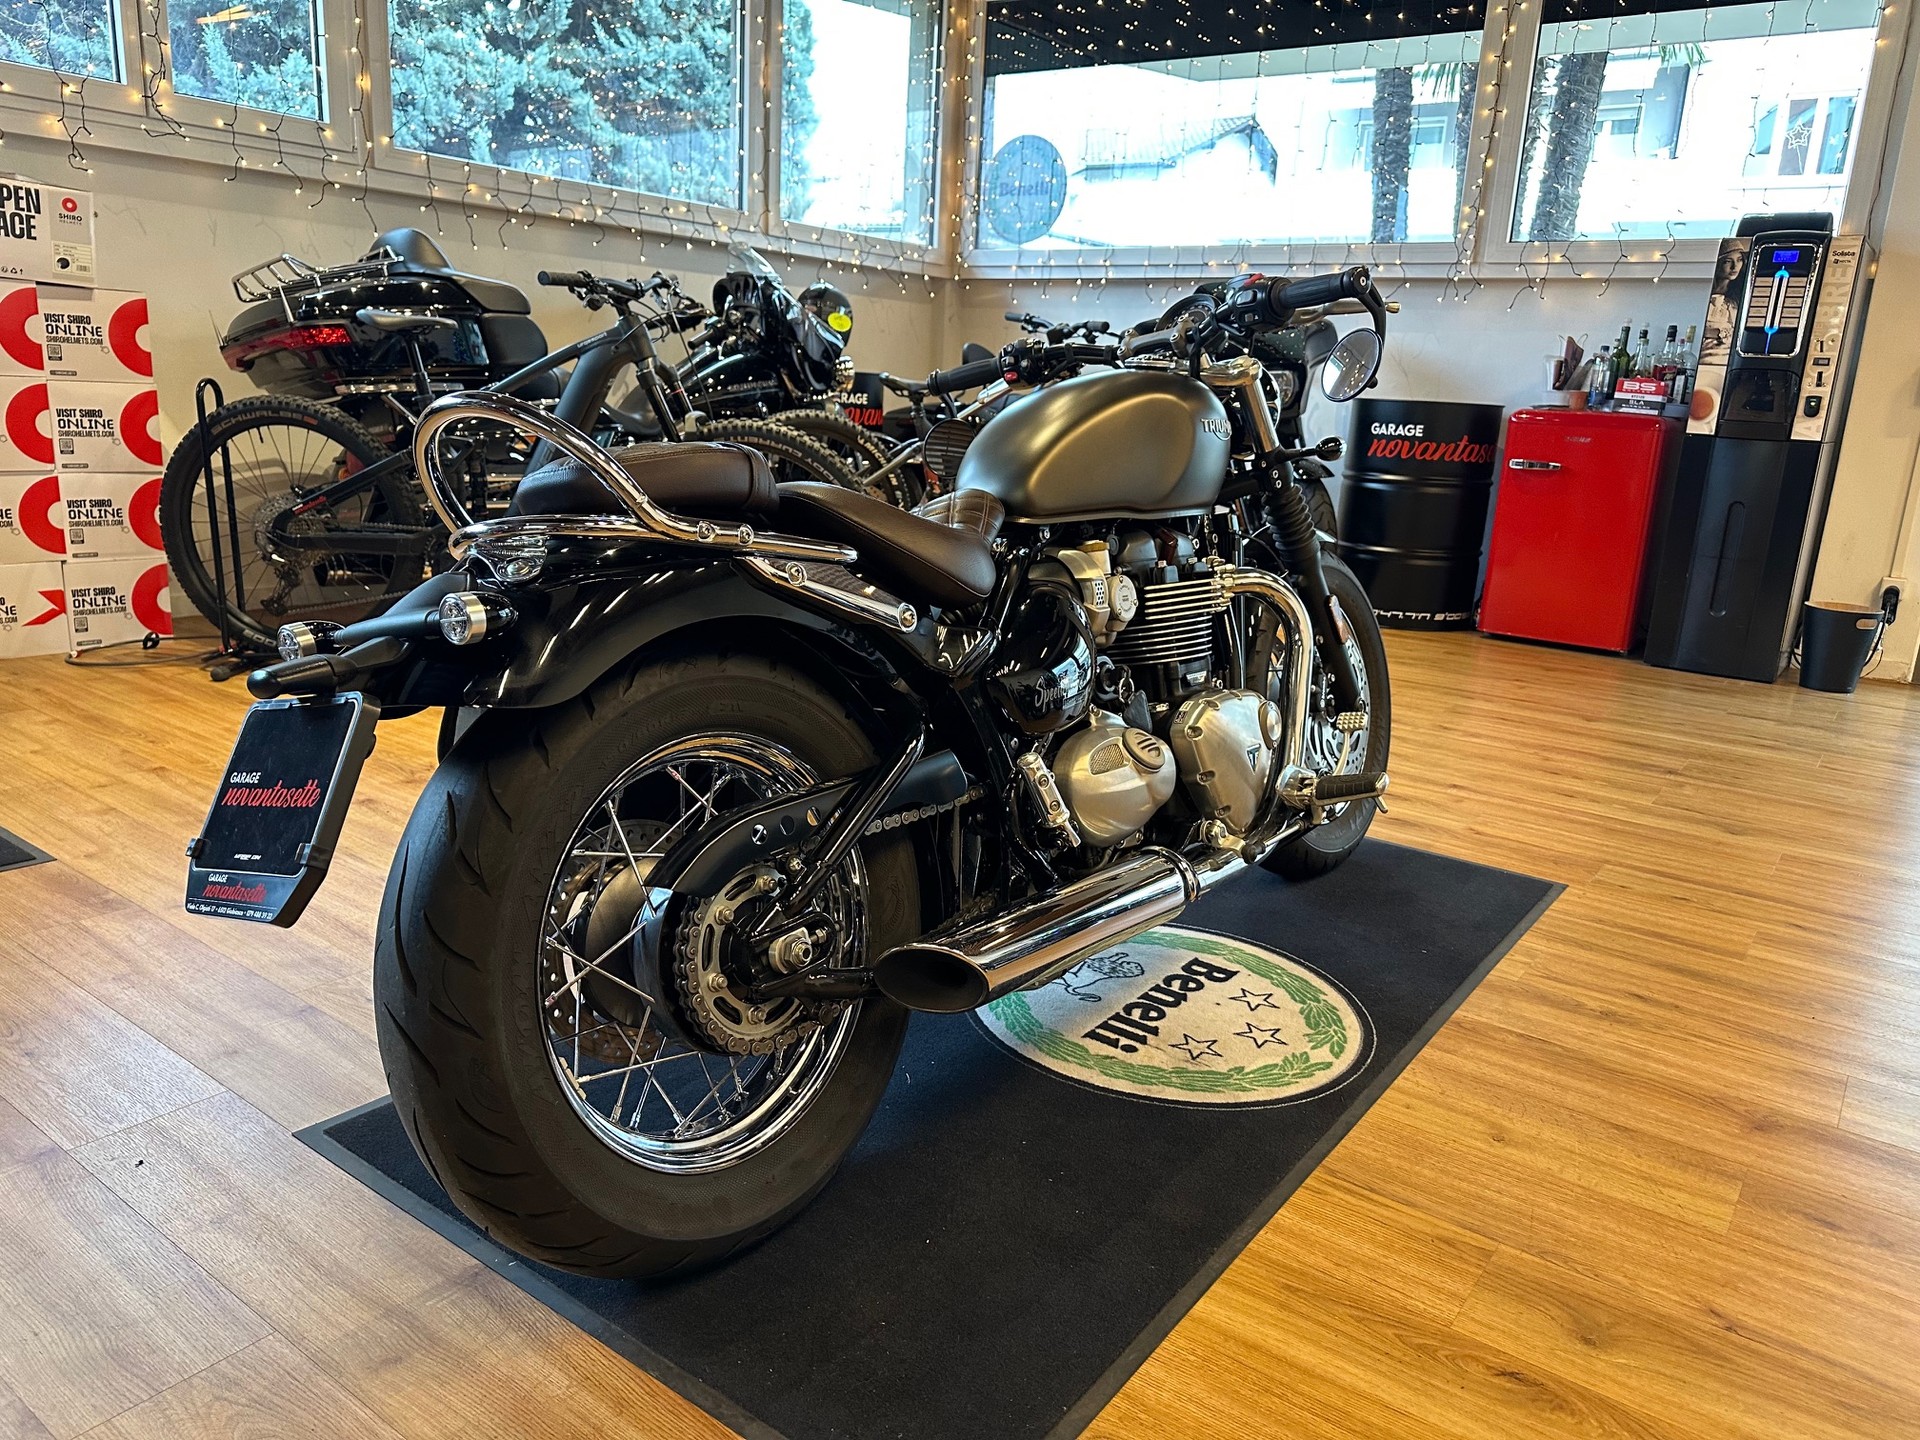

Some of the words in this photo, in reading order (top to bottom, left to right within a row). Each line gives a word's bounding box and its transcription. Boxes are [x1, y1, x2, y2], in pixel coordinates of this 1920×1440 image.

[58, 212, 83, 222] SHIRO
[43, 312, 66, 325] VISIT
[67, 313, 91, 325] SHIRO
[45, 323, 103, 338] ONLINE
[45, 334, 104, 346] SHIROHELMETS.COM
[1623, 382, 1657, 391] BS
[56, 408, 78, 419] VISIT
[79, 408, 103, 419] SHIRO
[57, 417, 114, 430] ONLINE
[1370, 422, 1424, 437] GARAGE
[57, 428, 115, 438] SHIROHELMETS.COM
[66, 499, 87, 509] VISIT
[89, 498, 112, 508] SHIRO
[68, 507, 123, 520] ONLINE
[68, 518, 124, 528] SHIROHELMETS.COM
[71, 588, 91, 598] VISIT
[93, 586, 115, 596] SHIRO
[72, 595, 126, 609] ONLINE
[72, 606, 127, 616] SHIROHELMETS.COM
[229, 771, 262, 784] GARAGE
[221, 779, 321, 808] novantasette
[208, 873, 229, 883] GARAGE
[1081, 957, 1240, 1053] Benelli
